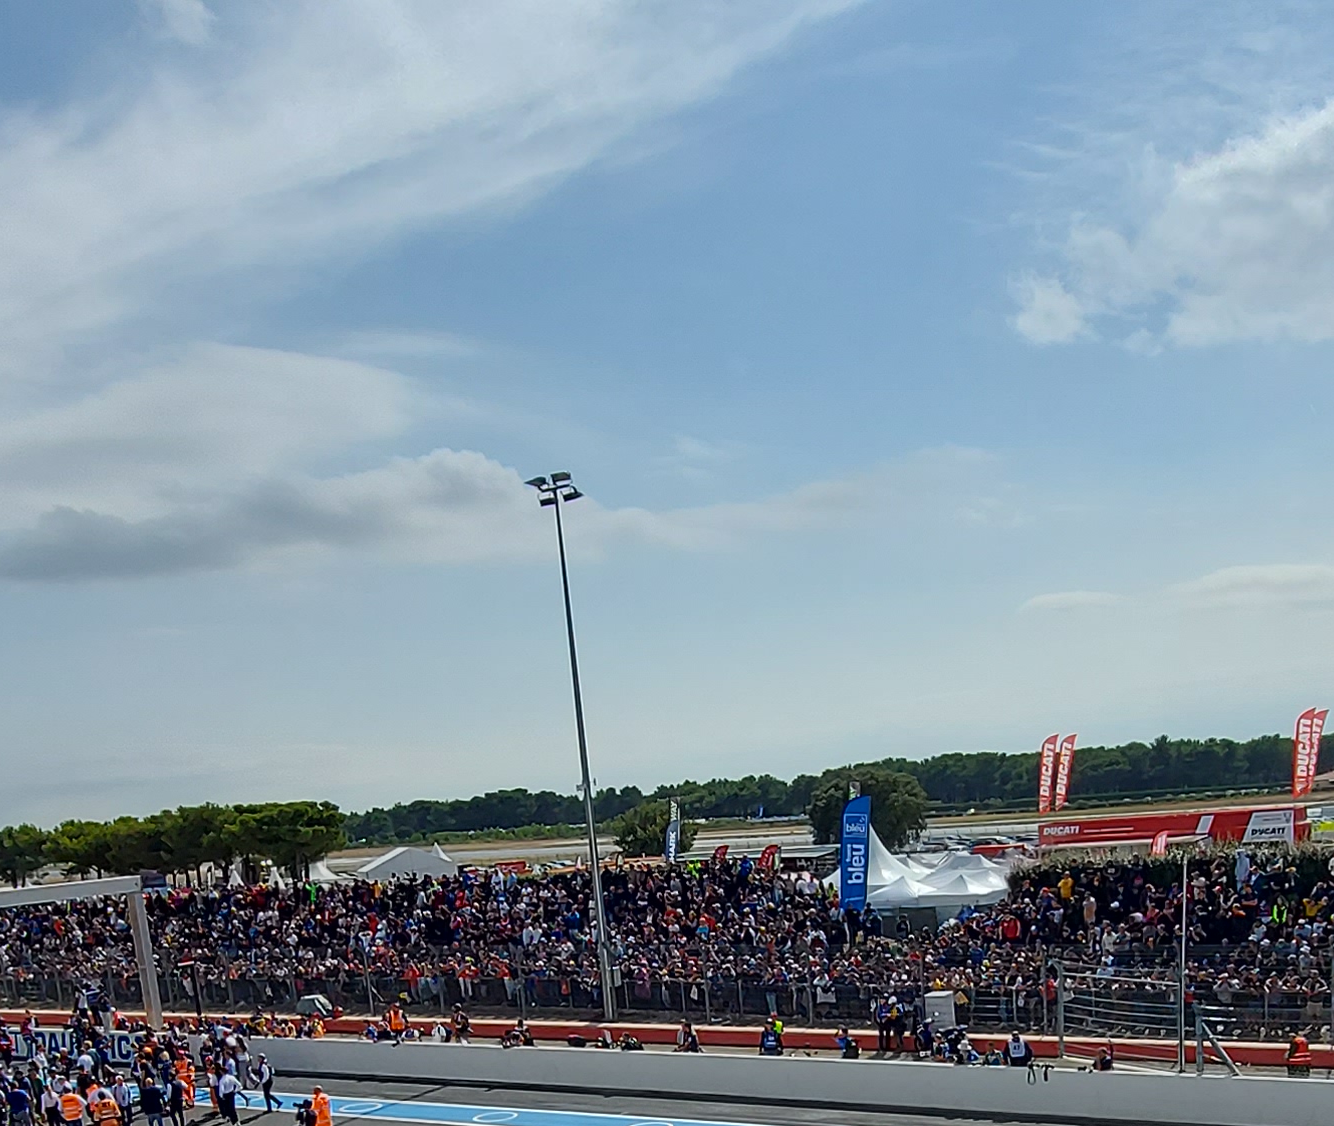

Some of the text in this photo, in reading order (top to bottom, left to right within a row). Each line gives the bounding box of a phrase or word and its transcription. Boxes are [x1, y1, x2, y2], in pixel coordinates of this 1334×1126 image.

[1039, 742, 1055, 797] DUCATI
[1056, 741, 1073, 796] DUCATI
[1297, 718, 1312, 776] DUCATI
[1042, 825, 1080, 836] DUCATI
[1251, 827, 1286, 836] DUCATI
[847, 844, 866, 885] bleu
